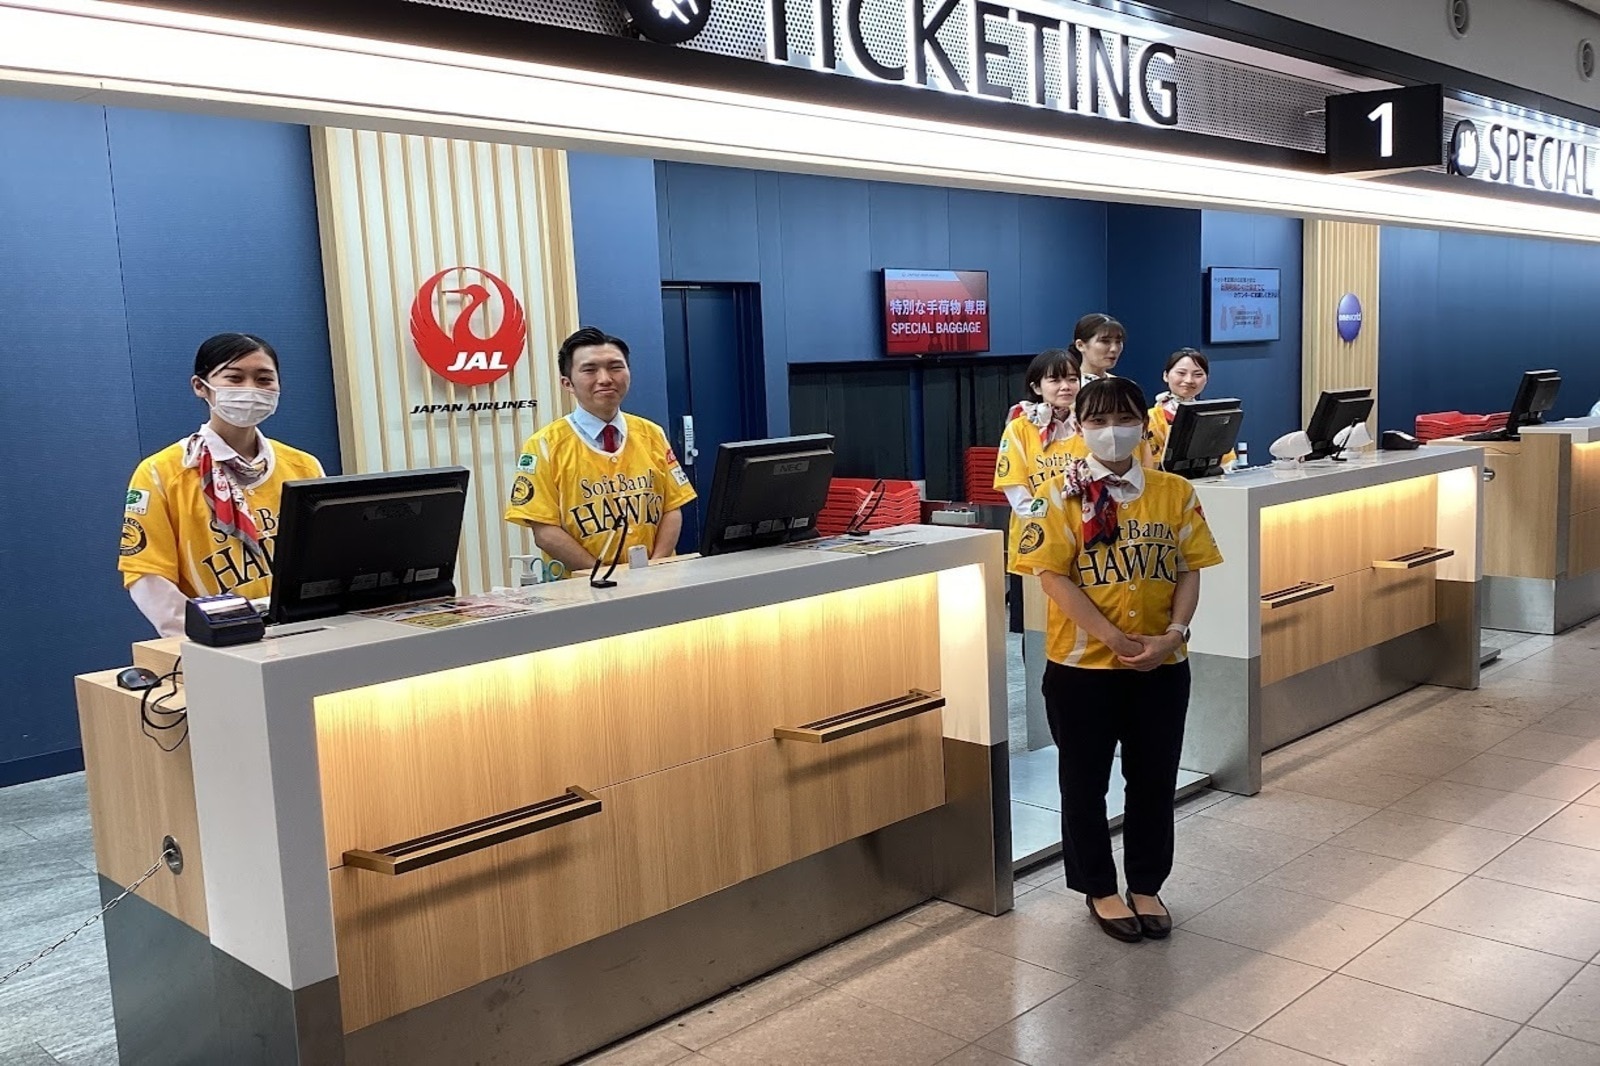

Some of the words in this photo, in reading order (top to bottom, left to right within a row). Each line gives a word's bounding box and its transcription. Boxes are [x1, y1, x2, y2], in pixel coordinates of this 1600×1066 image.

[1367, 102, 1393, 158] 1
[1489, 123, 1593, 195] SPECIAL
[890, 300, 961, 315] 特別な手荷物
[964, 300, 987, 315] 専用
[891, 322, 934, 334] SPECIAL
[936, 322, 981, 333] BAGGAGE
[447, 352, 508, 371] JAL
[410, 404, 463, 414] JAPAN
[466, 400, 538, 411] AIRLINES
[780, 463, 802, 472] NEC
